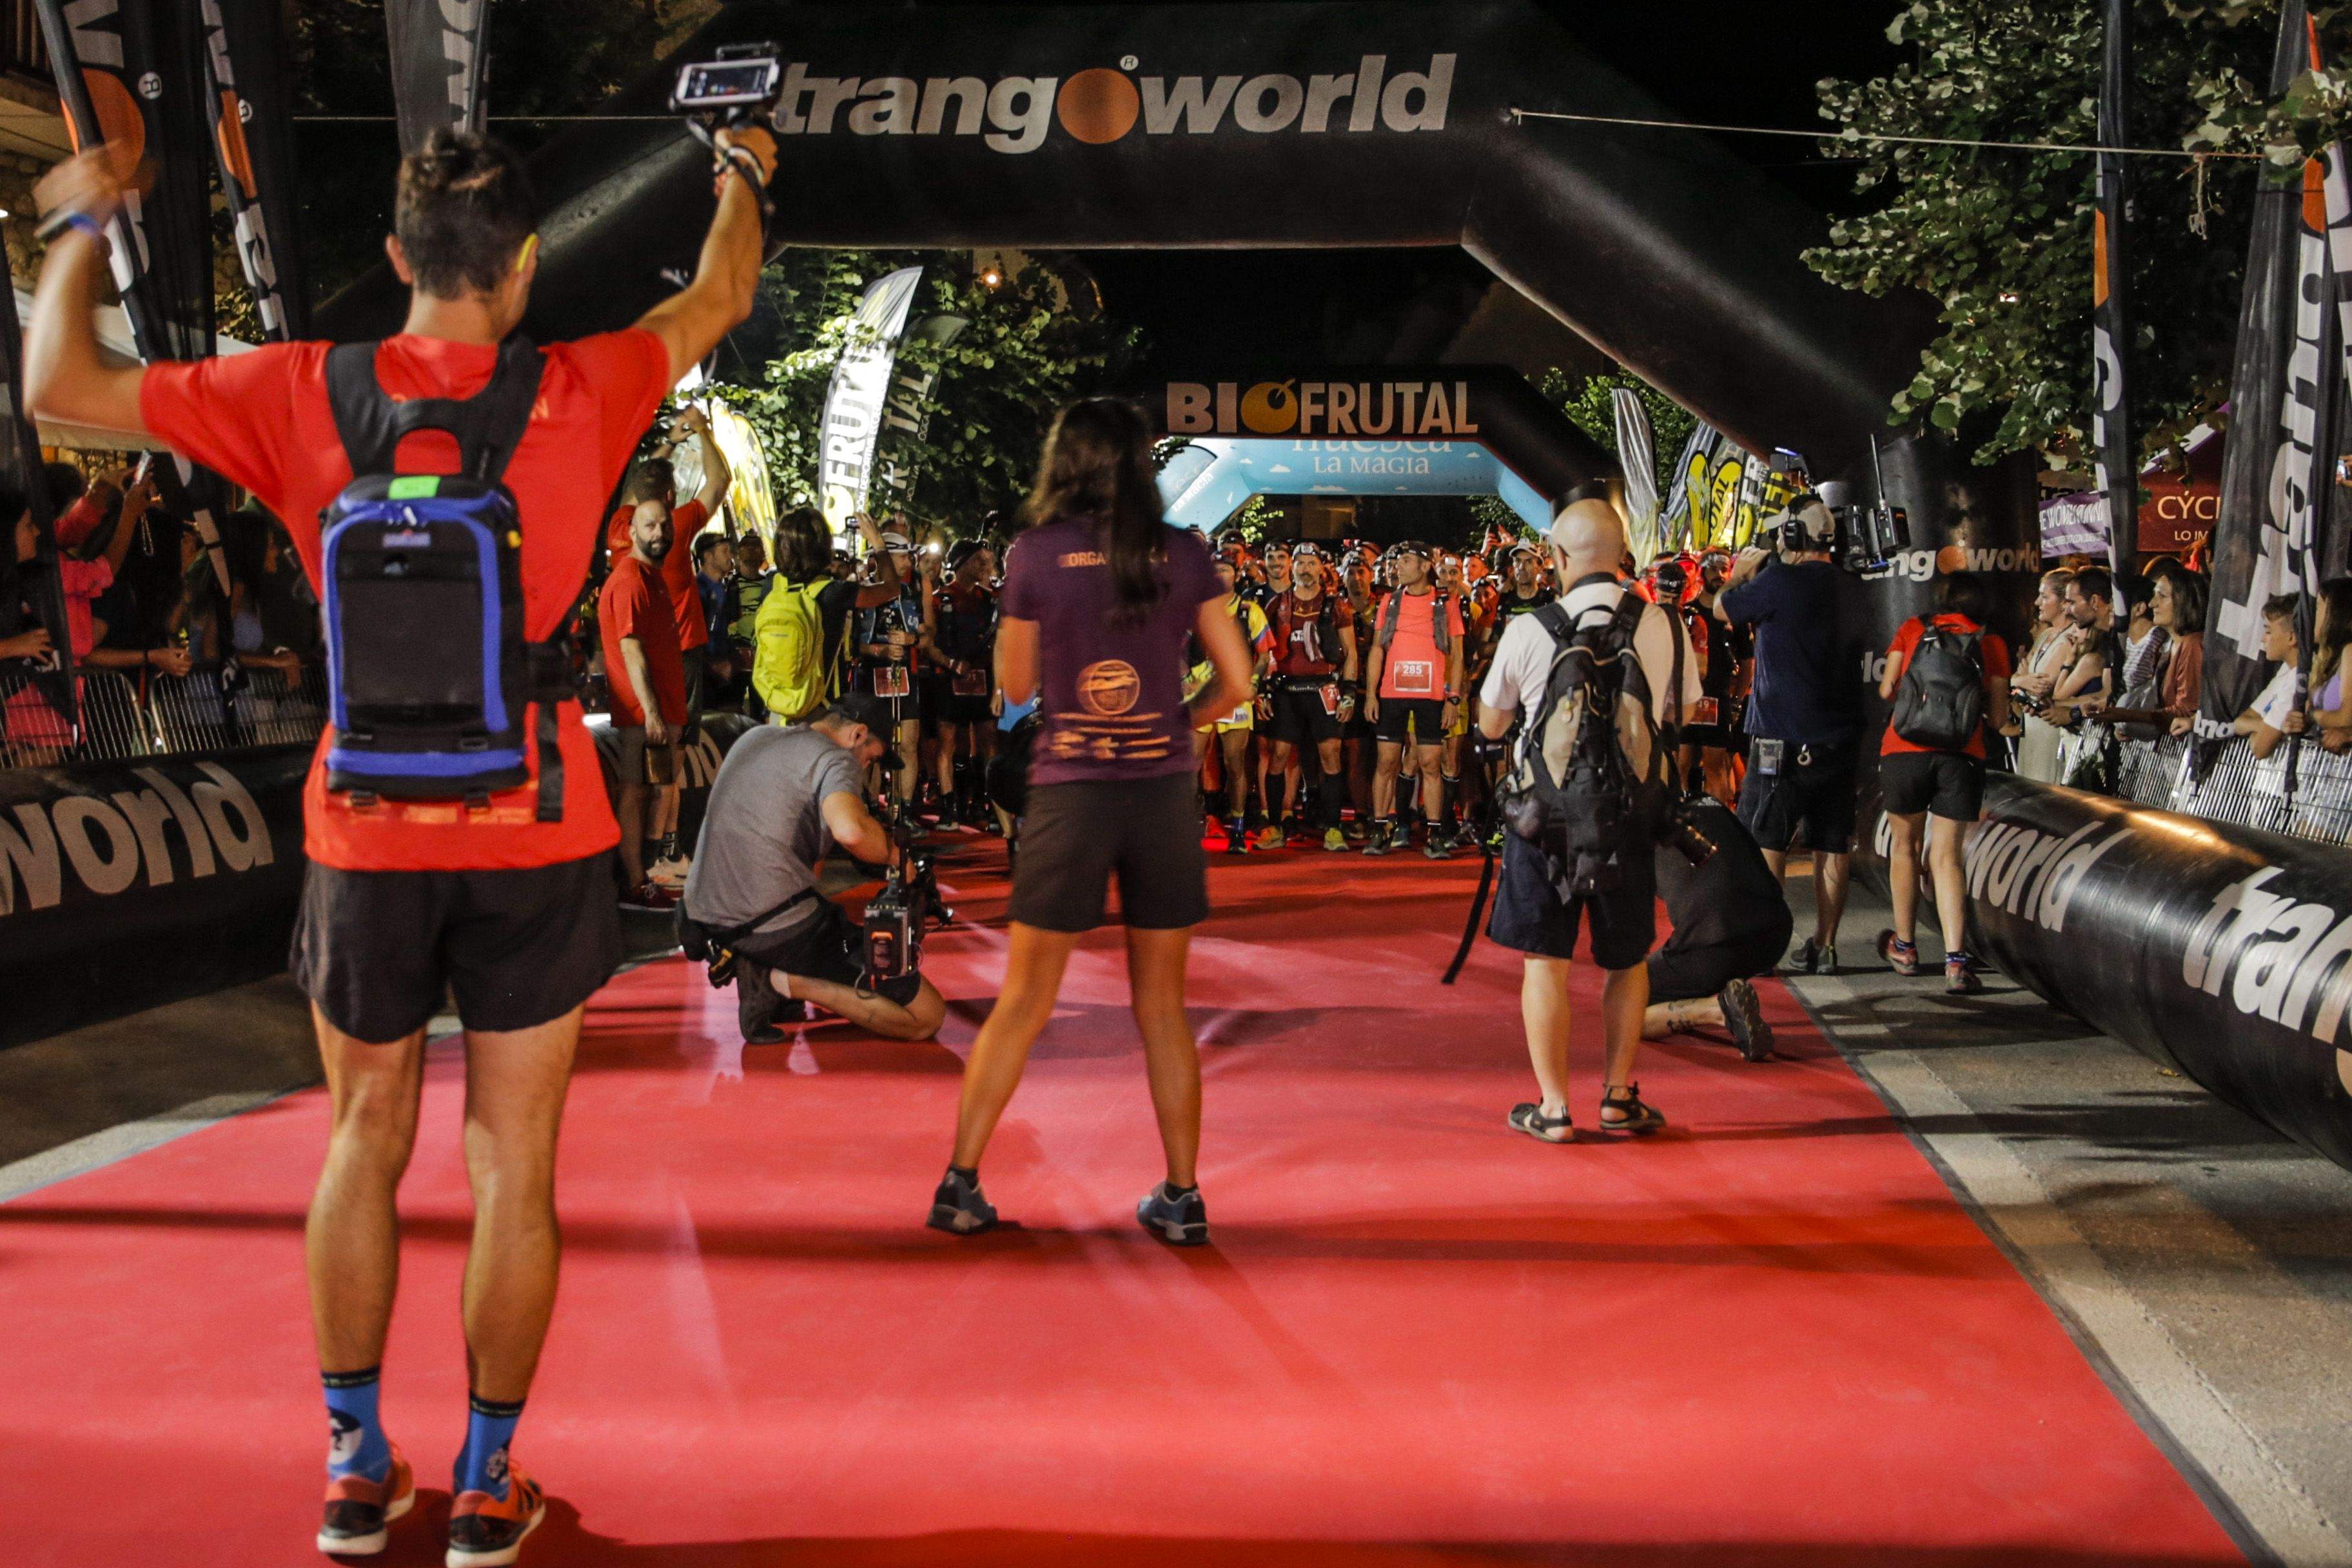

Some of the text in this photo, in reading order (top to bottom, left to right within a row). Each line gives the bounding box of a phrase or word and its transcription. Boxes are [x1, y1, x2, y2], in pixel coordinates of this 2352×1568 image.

[1167, 378, 1478, 435] BIOFRUTAL
[2175, 530, 2191, 541] LO
[1402, 665, 1422, 675] 285
